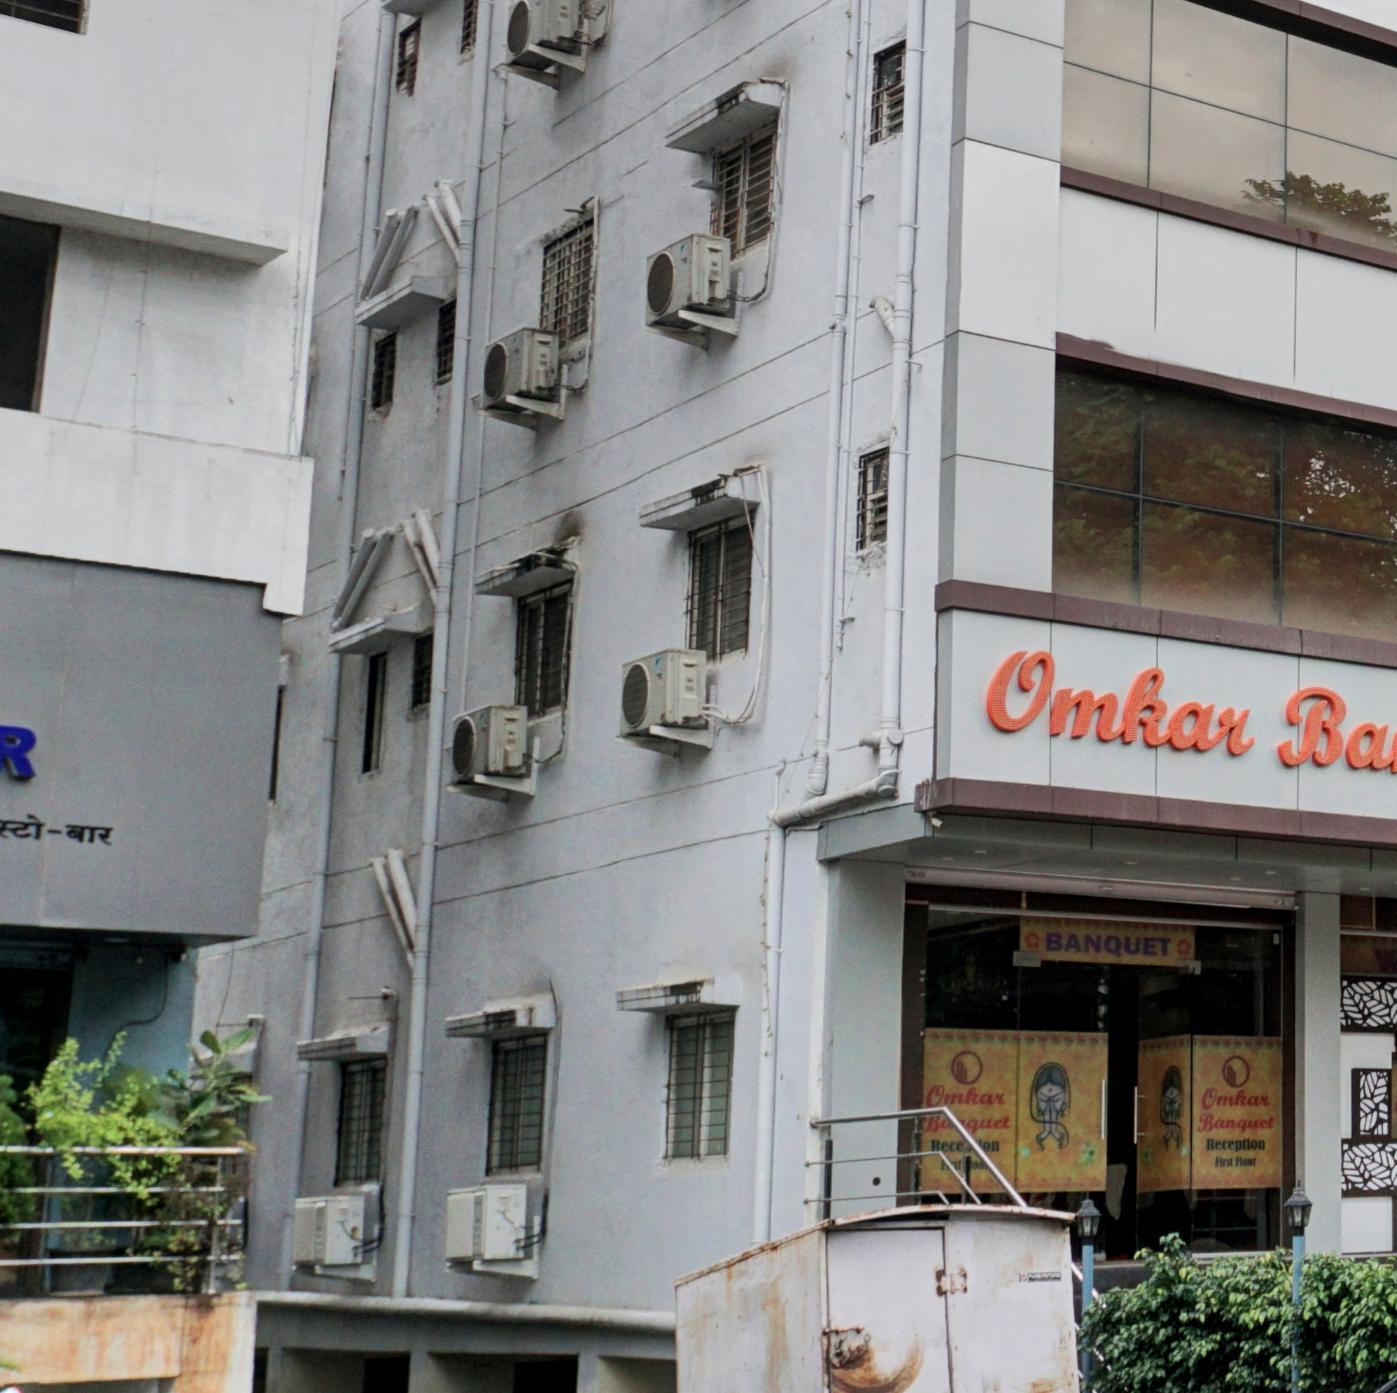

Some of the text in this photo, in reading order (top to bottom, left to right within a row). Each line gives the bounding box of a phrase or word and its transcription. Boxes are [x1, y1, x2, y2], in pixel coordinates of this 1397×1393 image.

[986, 649, 1256, 757] Omkar
[0, 724, 37, 782] R
[1045, 932, 1172, 957] BANQUET
[926, 1085, 1006, 1109] Omkar
[1201, 1088, 1271, 1110] Omkar
[1198, 1113, 1275, 1133] Banquet
[1206, 1138, 1266, 1152] Reception
